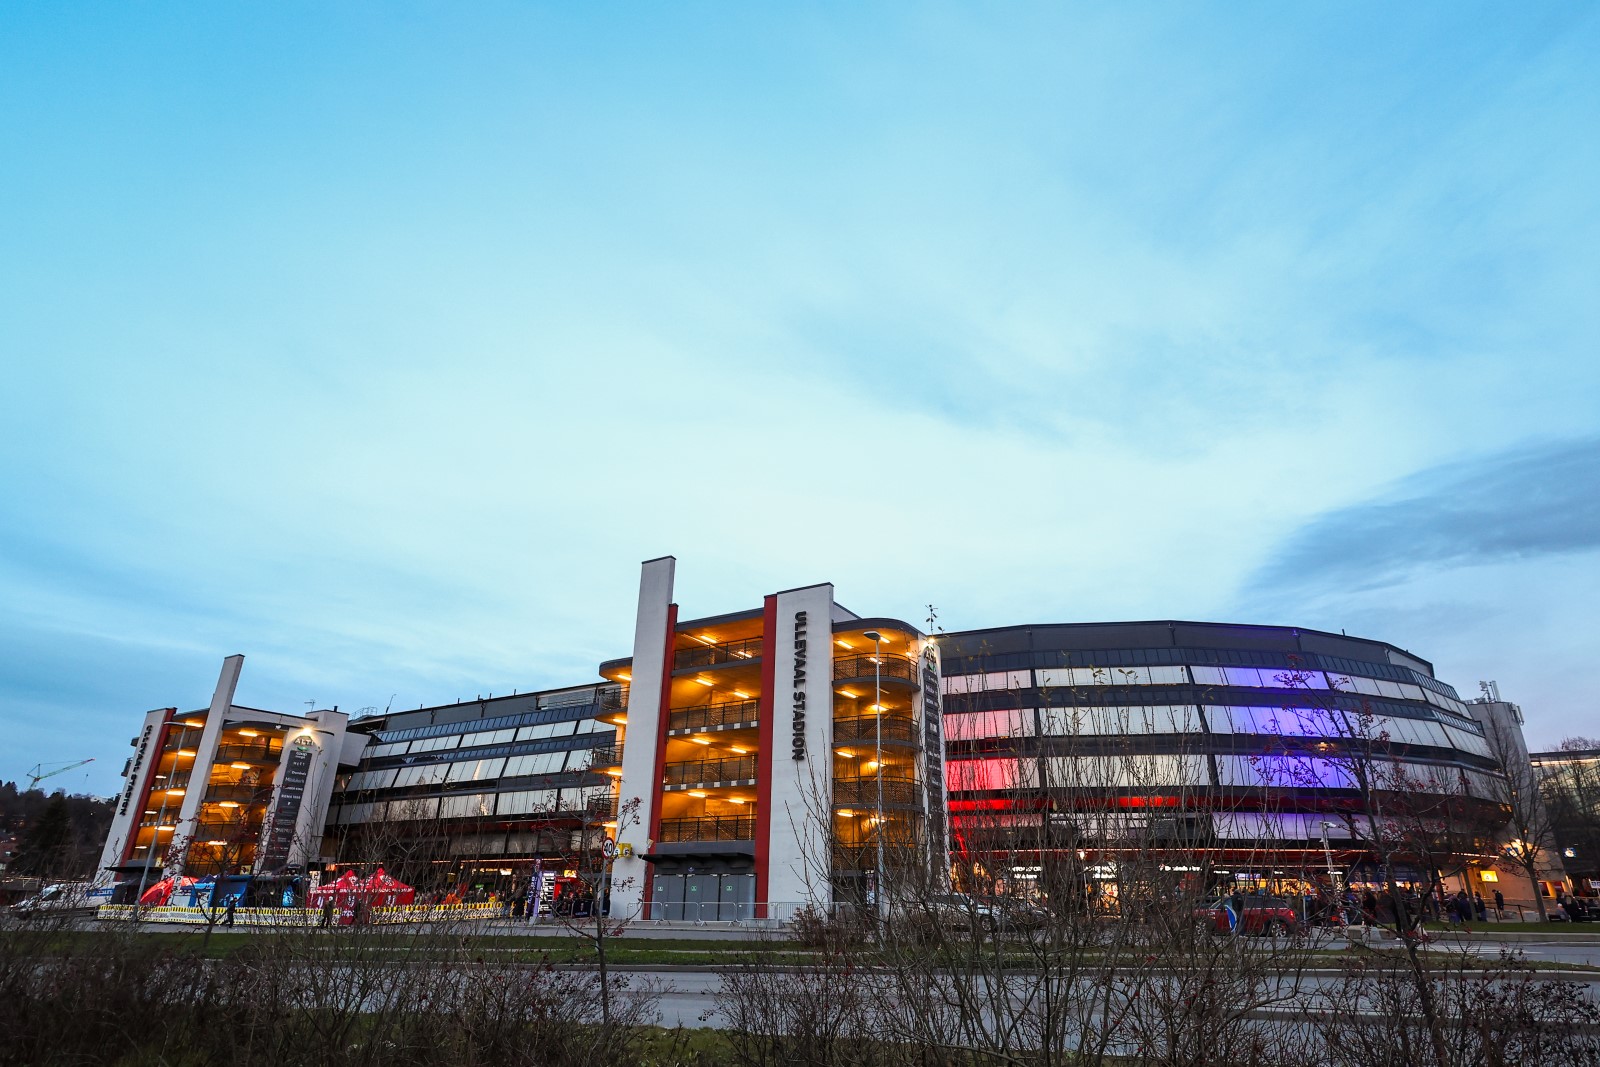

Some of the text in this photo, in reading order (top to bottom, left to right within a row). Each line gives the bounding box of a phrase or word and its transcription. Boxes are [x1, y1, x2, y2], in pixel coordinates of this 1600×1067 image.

[792, 611, 807, 761] ULLEVAAL STADION
[294, 738, 314, 746] ALTI
[119, 774, 137, 816] STADION
[604, 842, 612, 855] 40
